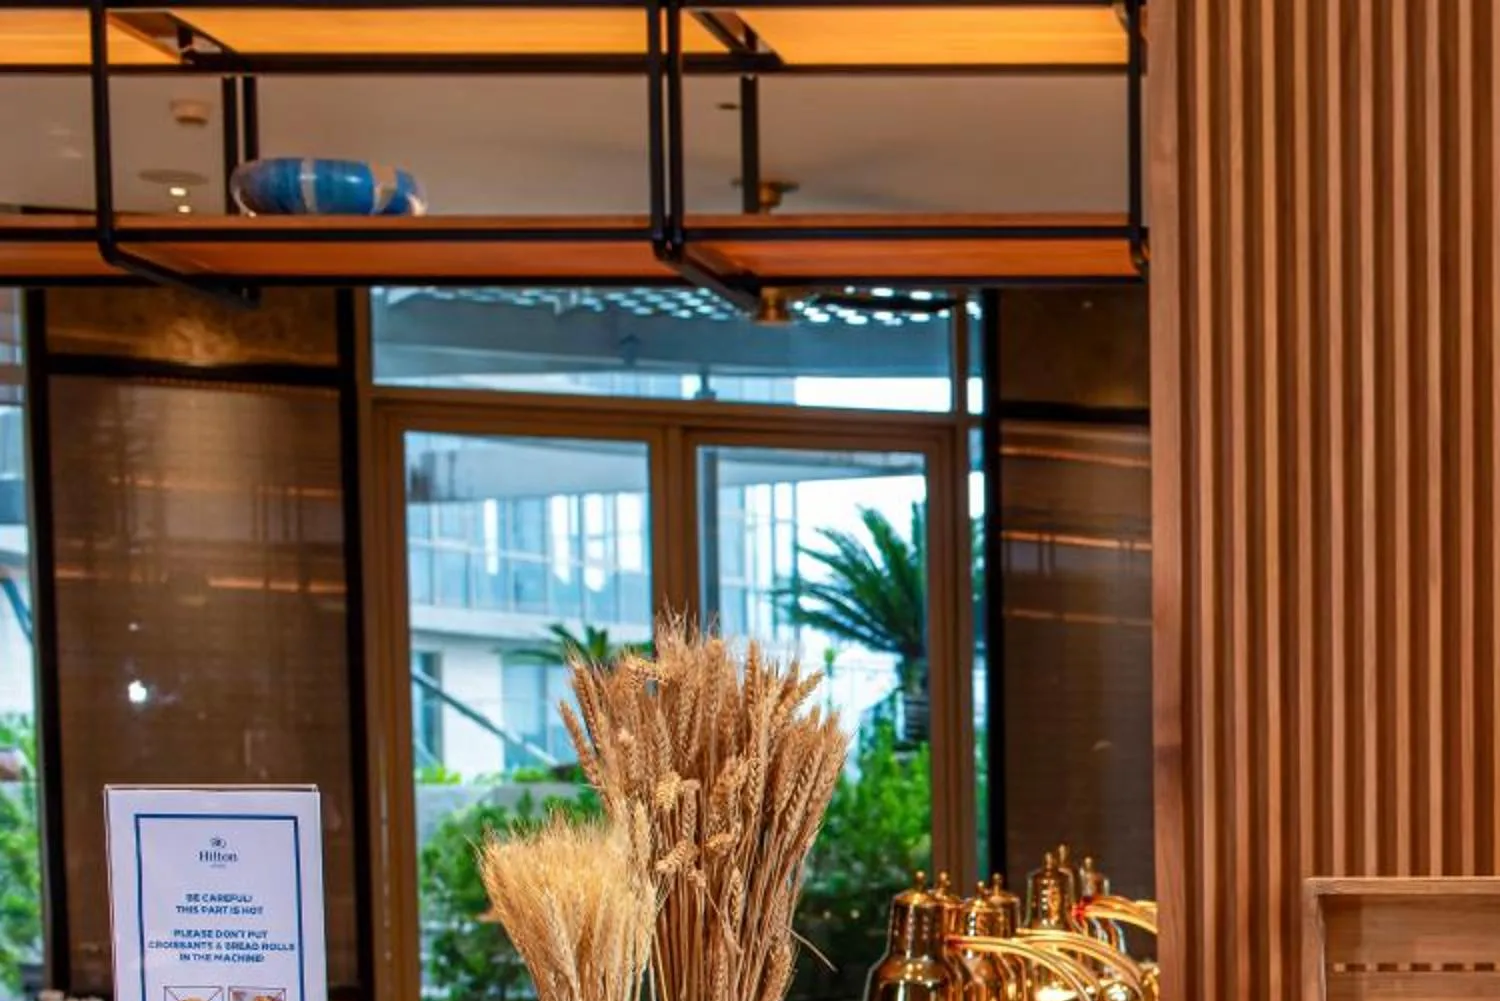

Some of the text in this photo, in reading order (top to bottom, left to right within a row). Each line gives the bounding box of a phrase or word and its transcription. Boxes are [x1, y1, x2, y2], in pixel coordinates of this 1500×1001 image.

[199, 850, 239, 863] Hilton
[176, 905, 199, 915] THIS
[201, 905, 228, 915] PART
[229, 906, 241, 915] IS
[173, 929, 213, 939] PLEASE
[224, 941, 259, 951] BREAD
[179, 953, 191, 962] IN
[192, 953, 212, 962] THE
